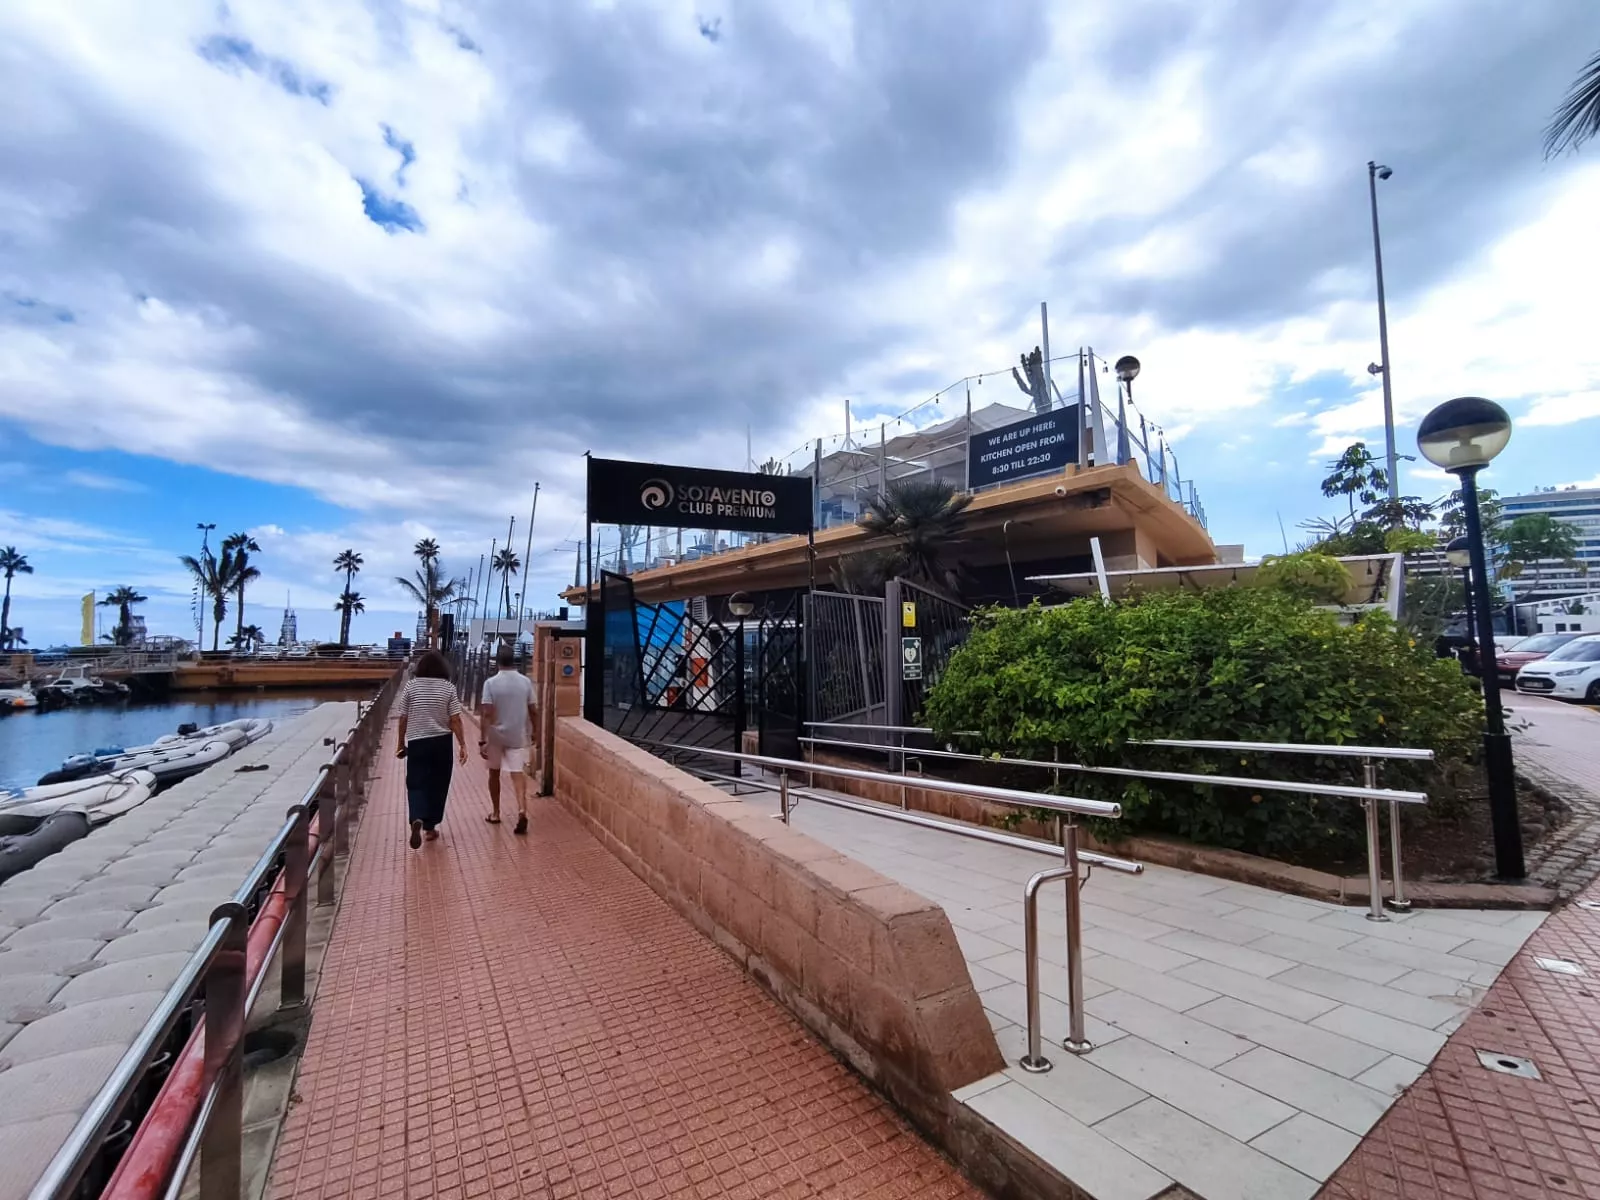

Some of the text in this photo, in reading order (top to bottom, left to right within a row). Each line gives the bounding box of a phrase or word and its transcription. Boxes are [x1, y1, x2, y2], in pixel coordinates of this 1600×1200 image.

[988, 436, 1001, 446] WE
[1002, 431, 1017, 442] ARE
[1019, 427, 1031, 437] UP
[980, 433, 1065, 463] KITCHEN OPEN FROM
[992, 452, 1051, 475] 8:30 TILL 22:30
[677, 485, 776, 506] SOTAVENTO
[678, 501, 776, 519] CLUB PREMIUM
